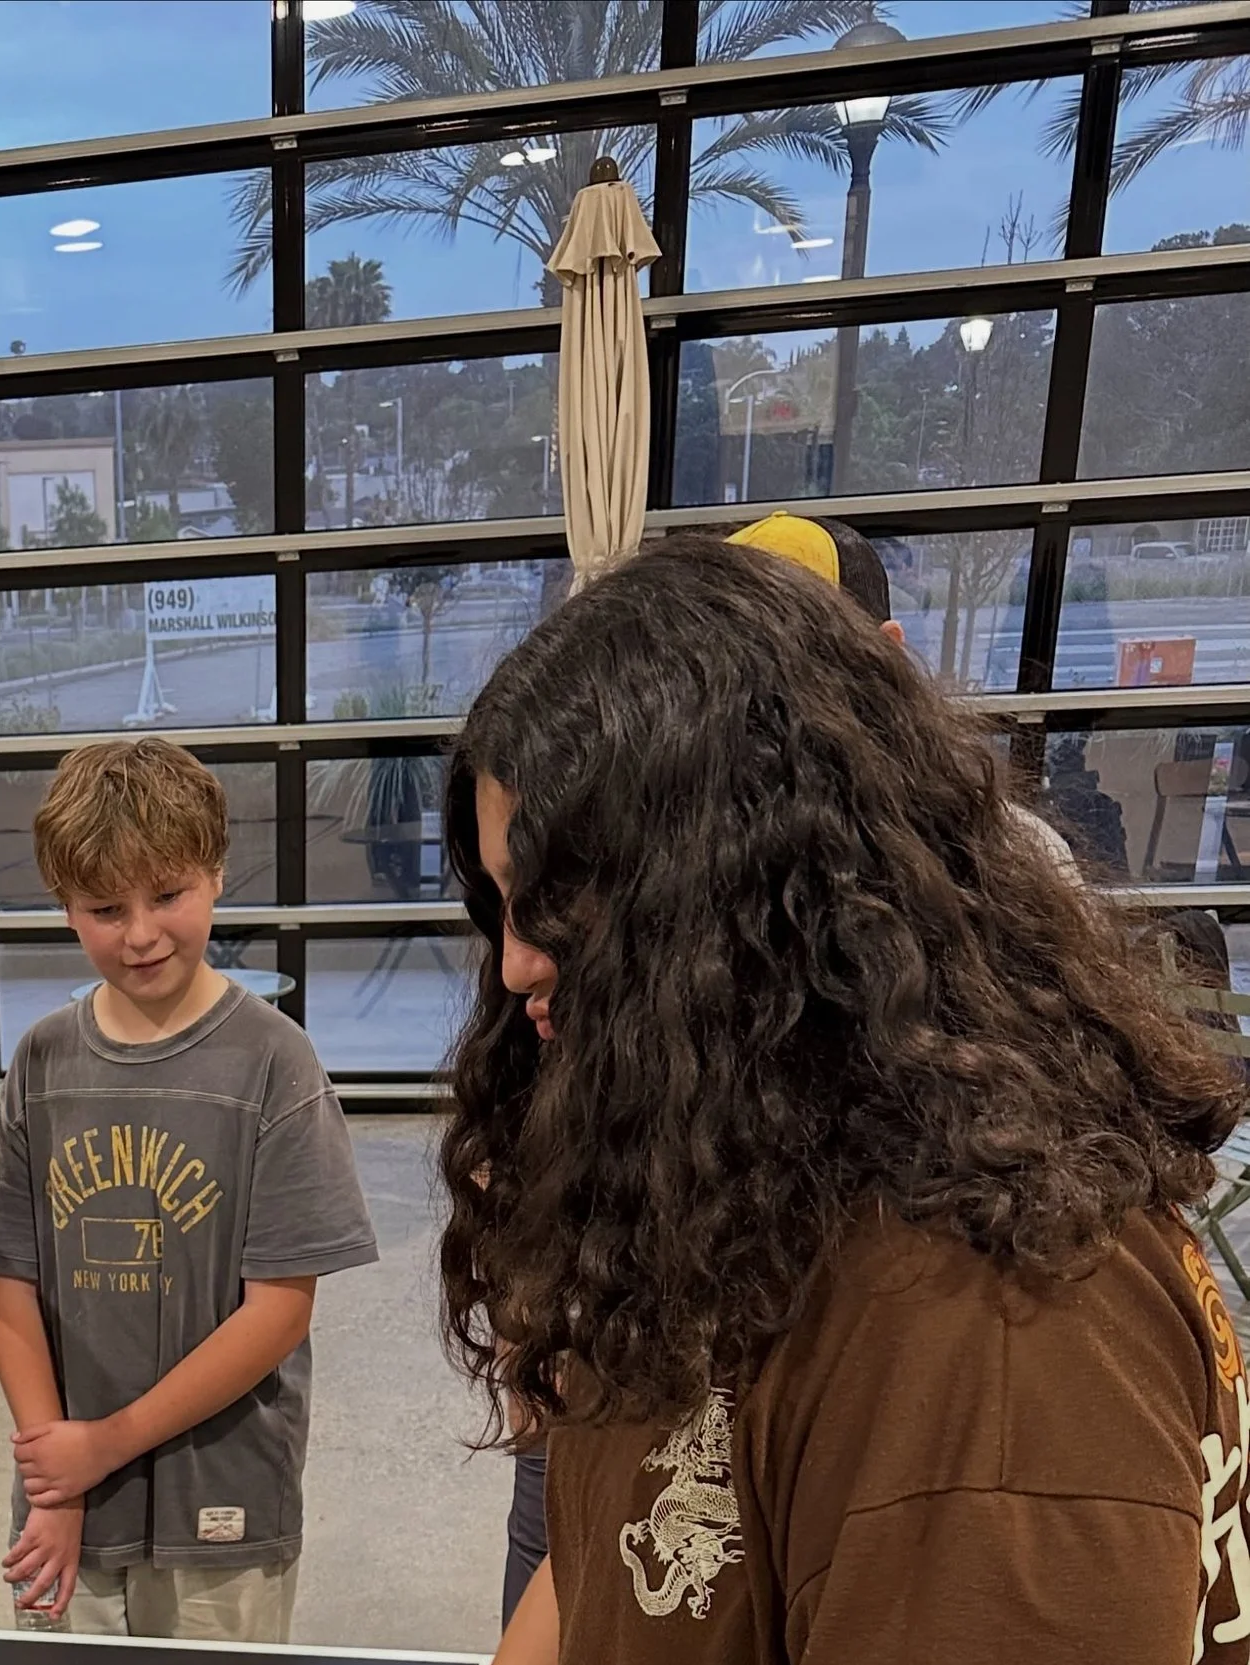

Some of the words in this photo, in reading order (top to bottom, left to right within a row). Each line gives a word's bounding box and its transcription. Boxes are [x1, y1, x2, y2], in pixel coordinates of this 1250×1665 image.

[148, 586, 195, 614] (949)
[148, 615, 214, 633] MARSHALL
[73, 1269, 100, 1289] NEW
[108, 1272, 151, 1292] YORK
